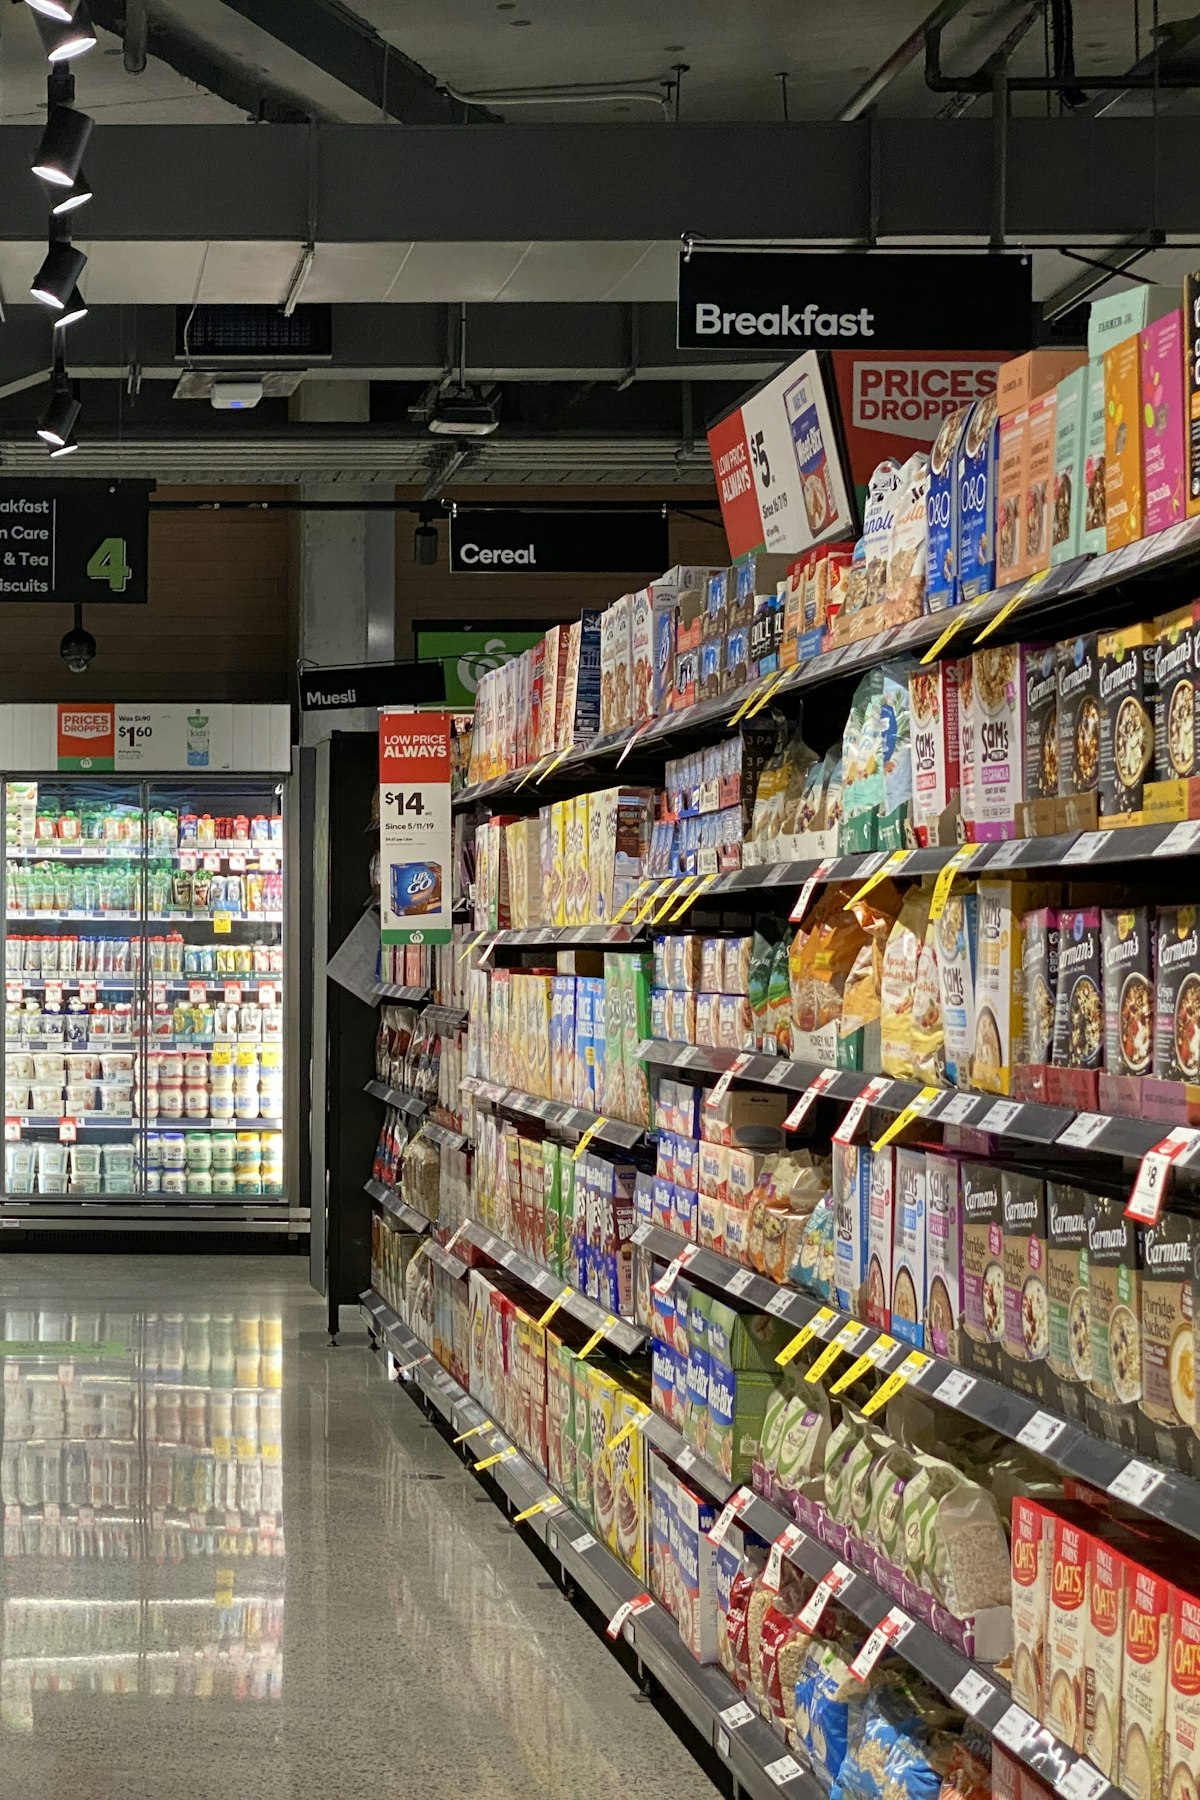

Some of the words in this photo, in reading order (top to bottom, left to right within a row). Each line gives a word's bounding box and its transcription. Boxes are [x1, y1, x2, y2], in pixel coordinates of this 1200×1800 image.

[695, 303, 875, 337] Breakfast
[860, 369, 997, 398] PRICES
[860, 400, 964, 421] DROPP
[716, 452, 732, 477] LOW
[729, 441, 747, 469] PRICE
[750, 430, 771, 489] $5
[720, 464, 752, 504] ALWAYS
[762, 502, 775, 520] Since
[11, 526, 49, 540] Care
[3, 552, 16, 566] &
[18, 552, 49, 566] Tea
[86, 537, 133, 592] 4
[459, 543, 537, 565] Cereal
[1059, 654, 1093, 698] Carman's
[1100, 650, 1138, 699] Carman's
[306, 689, 357, 706] Muesli
[64, 715, 109, 725] PRICES
[64, 725, 109, 733] DROPPED
[383, 745, 448, 758] ALWAYS
[384, 735, 411, 745] LOW
[412, 734, 447, 745] PRICE
[385, 791, 425, 816] $14
[385, 822, 407, 830] Since
[407, 822, 435, 831] 5/11/19
[407, 878, 433, 895] GO
[1158, 930, 1198, 968] Carman's
[964, 1180, 998, 1213] Carman's
[1003, 1184, 1039, 1221] Carman's
[1088, 1212, 1128, 1251] Carman's
[1142, 1288, 1177, 1322] Porridge
[1014, 1539, 1037, 1571] OATS
[1053, 1560, 1083, 1595] OATS
[1091, 1584, 1117, 1618] OATS
[1128, 1608, 1156, 1644] OATS
